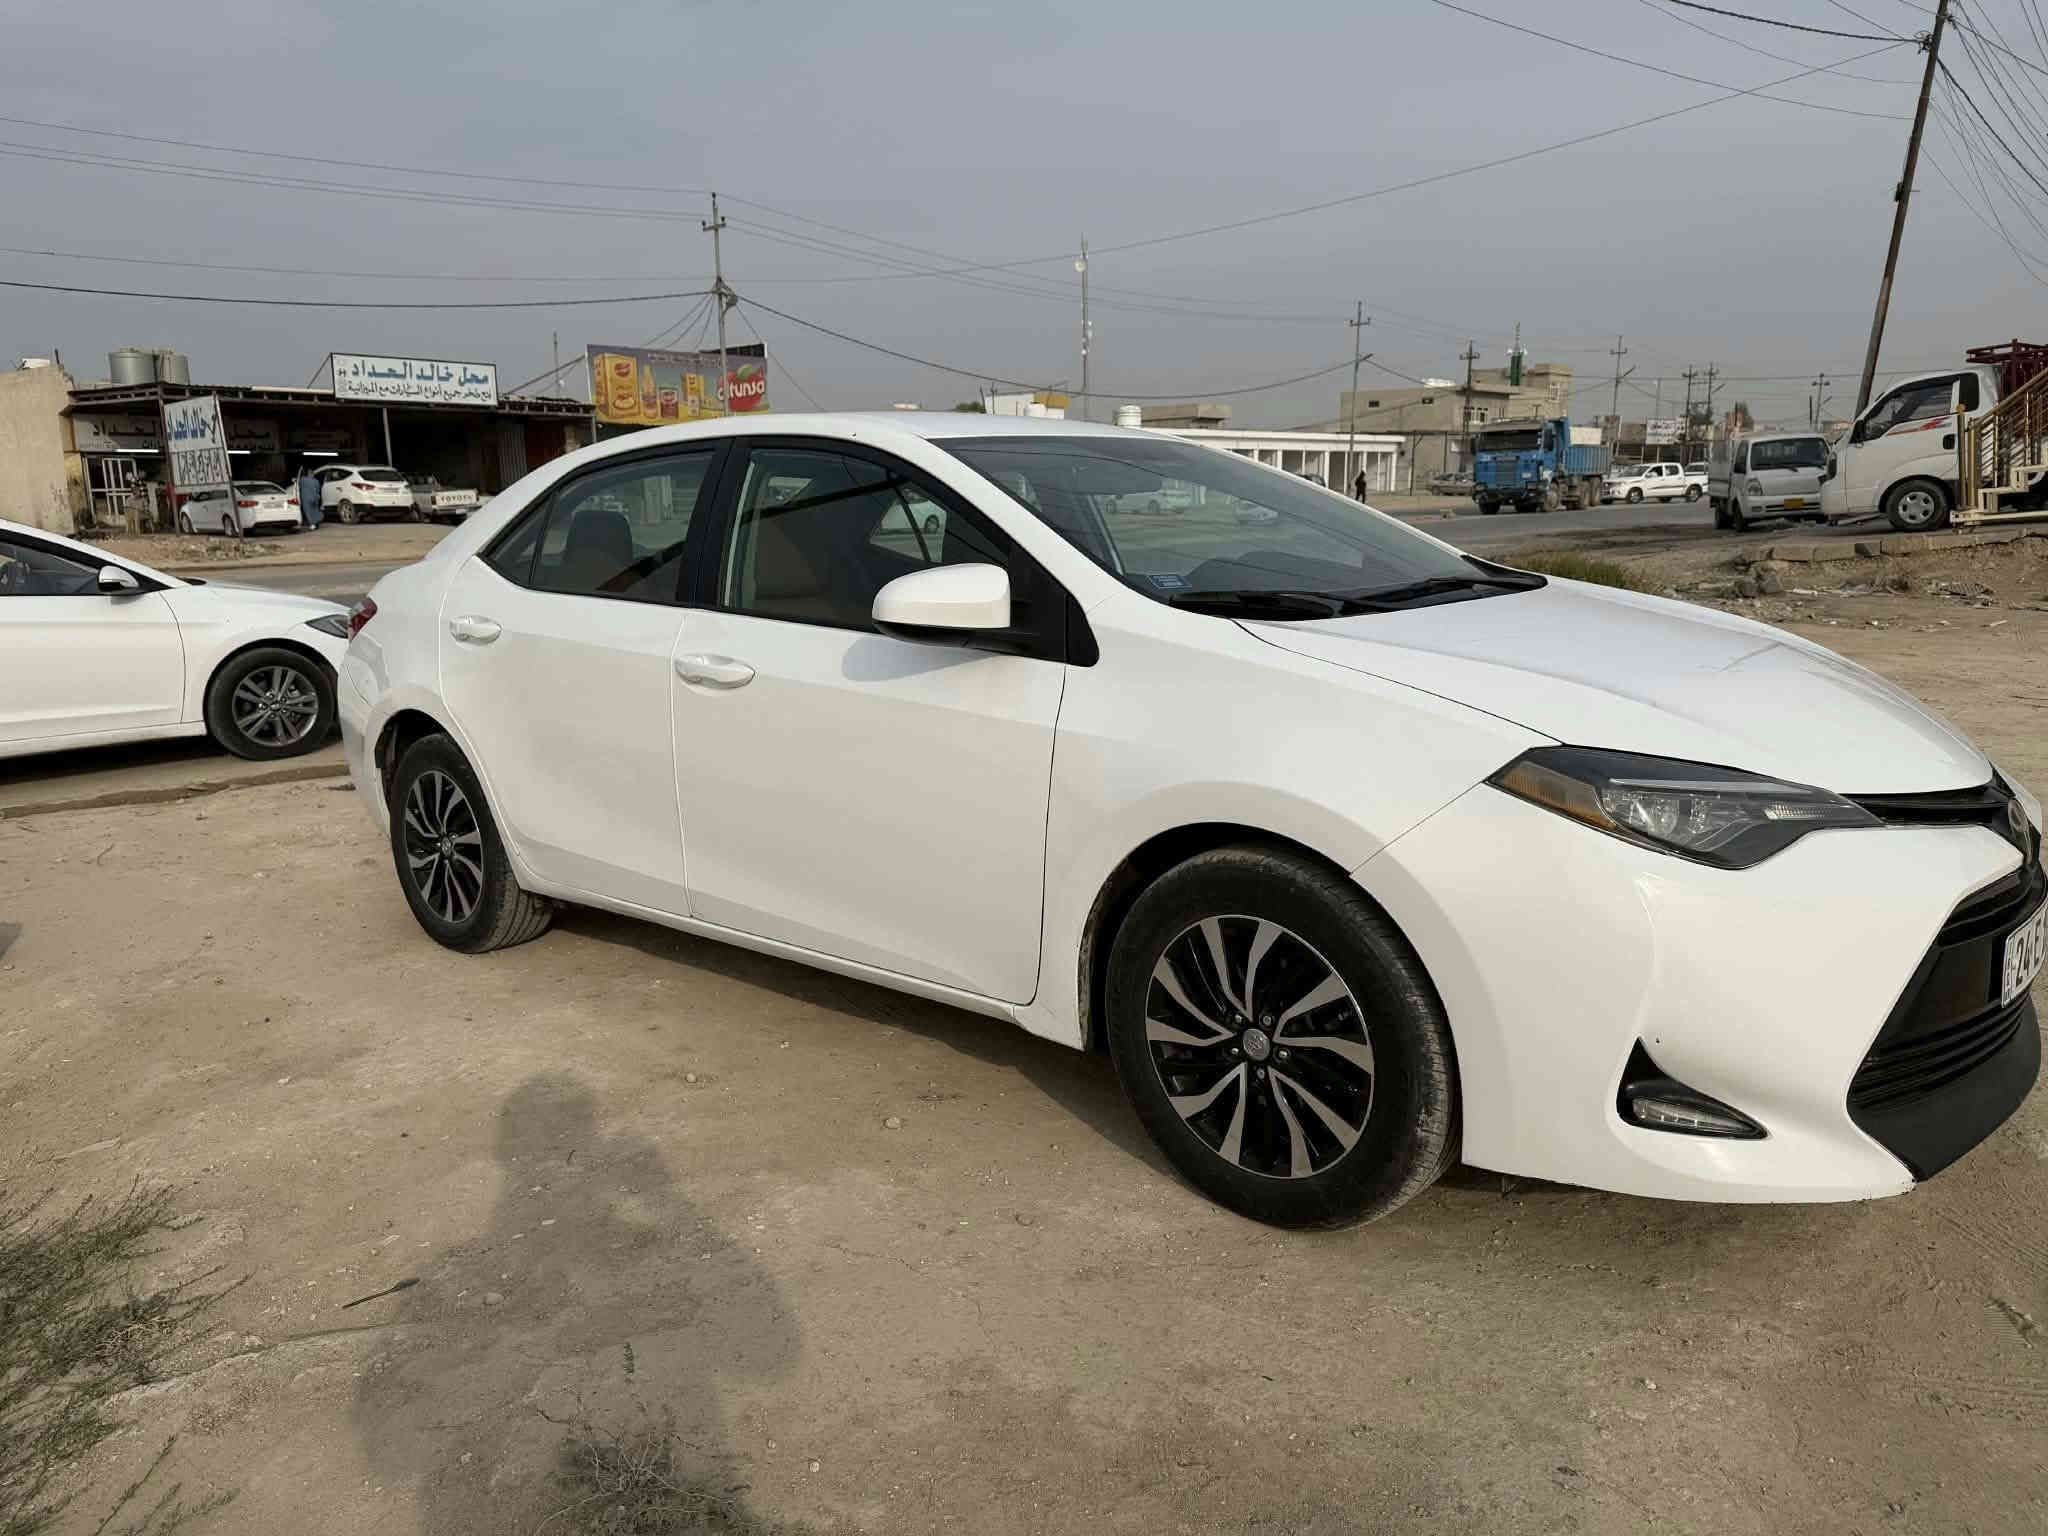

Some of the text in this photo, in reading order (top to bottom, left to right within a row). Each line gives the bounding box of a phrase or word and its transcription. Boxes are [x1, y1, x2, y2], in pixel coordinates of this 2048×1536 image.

[352, 359, 489, 386] محل خالد الحداد
